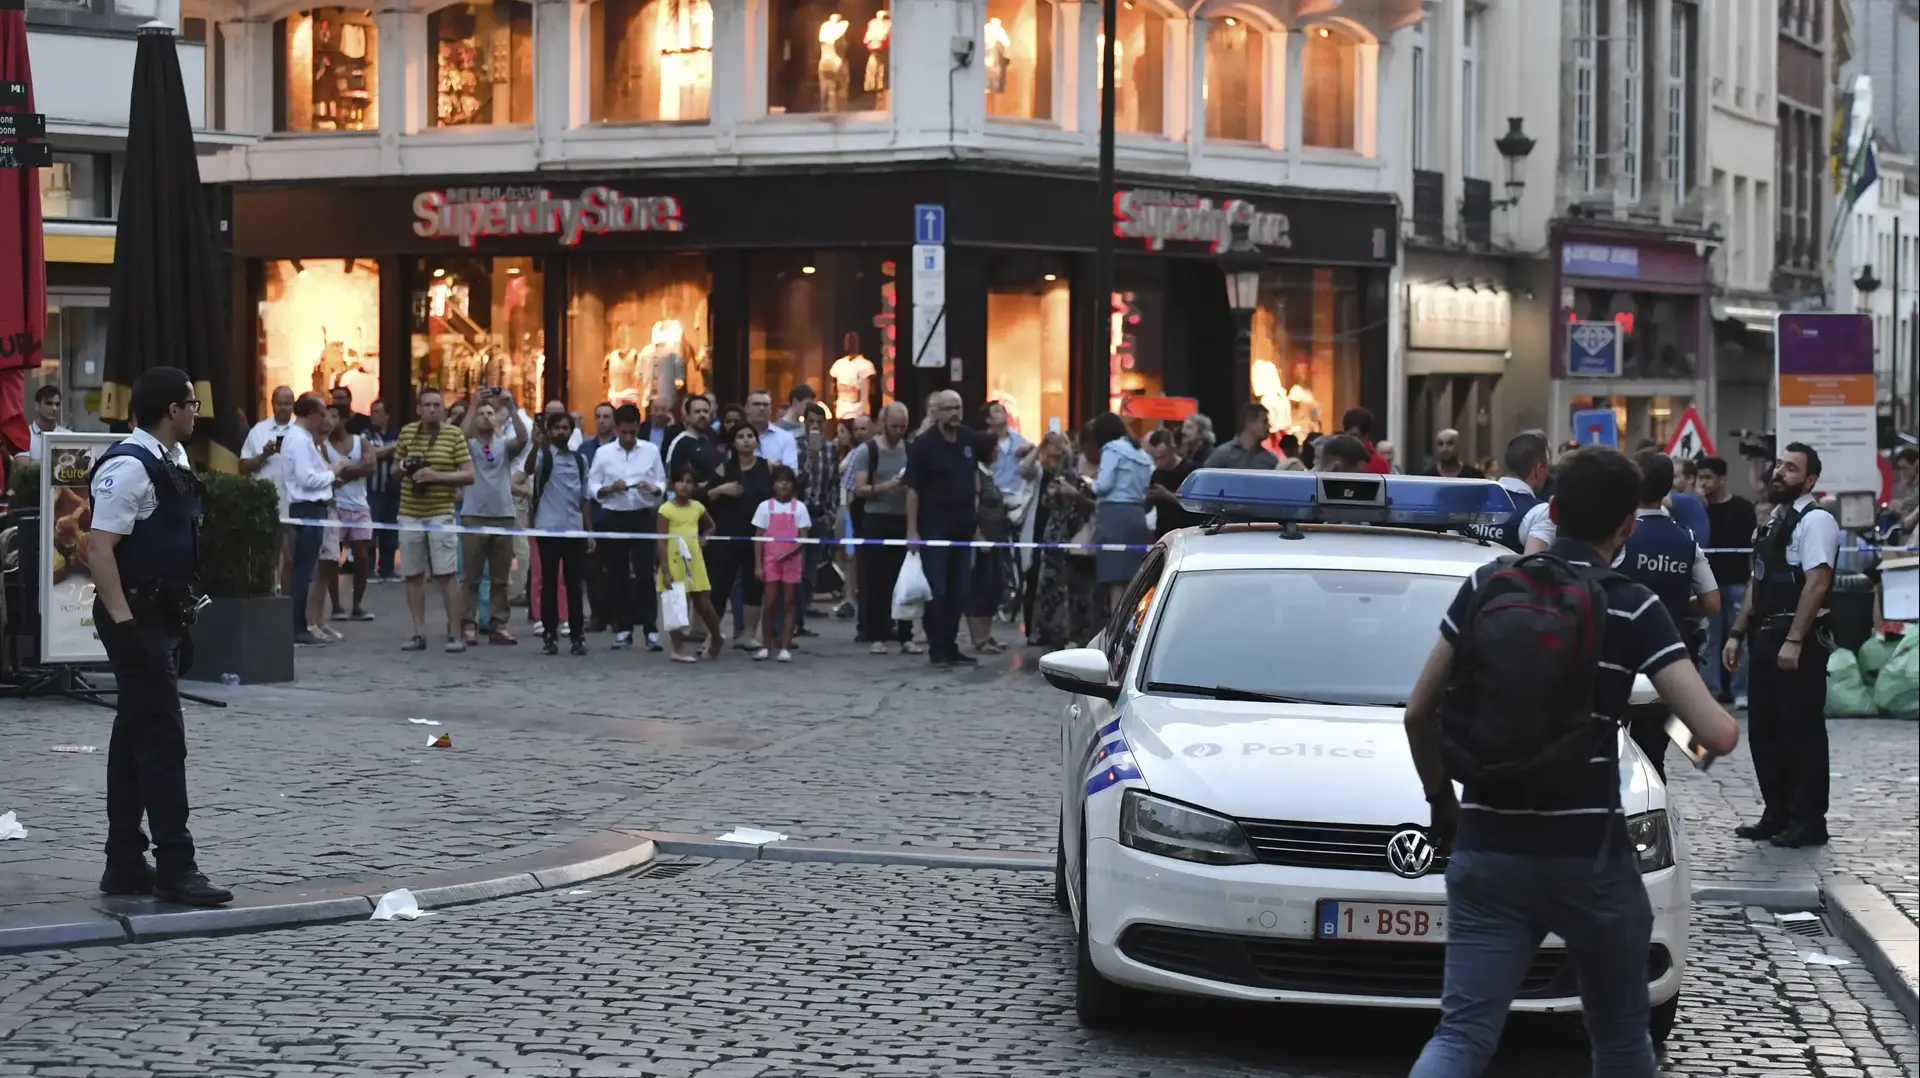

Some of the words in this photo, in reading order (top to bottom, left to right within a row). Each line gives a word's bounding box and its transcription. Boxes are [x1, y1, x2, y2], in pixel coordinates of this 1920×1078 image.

[1468, 523, 1504, 540] olice
[1636, 553, 1688, 574] Police
[1241, 742, 1376, 760] Police
[1323, 922, 1335, 935] B
[1343, 907, 1354, 933] 1
